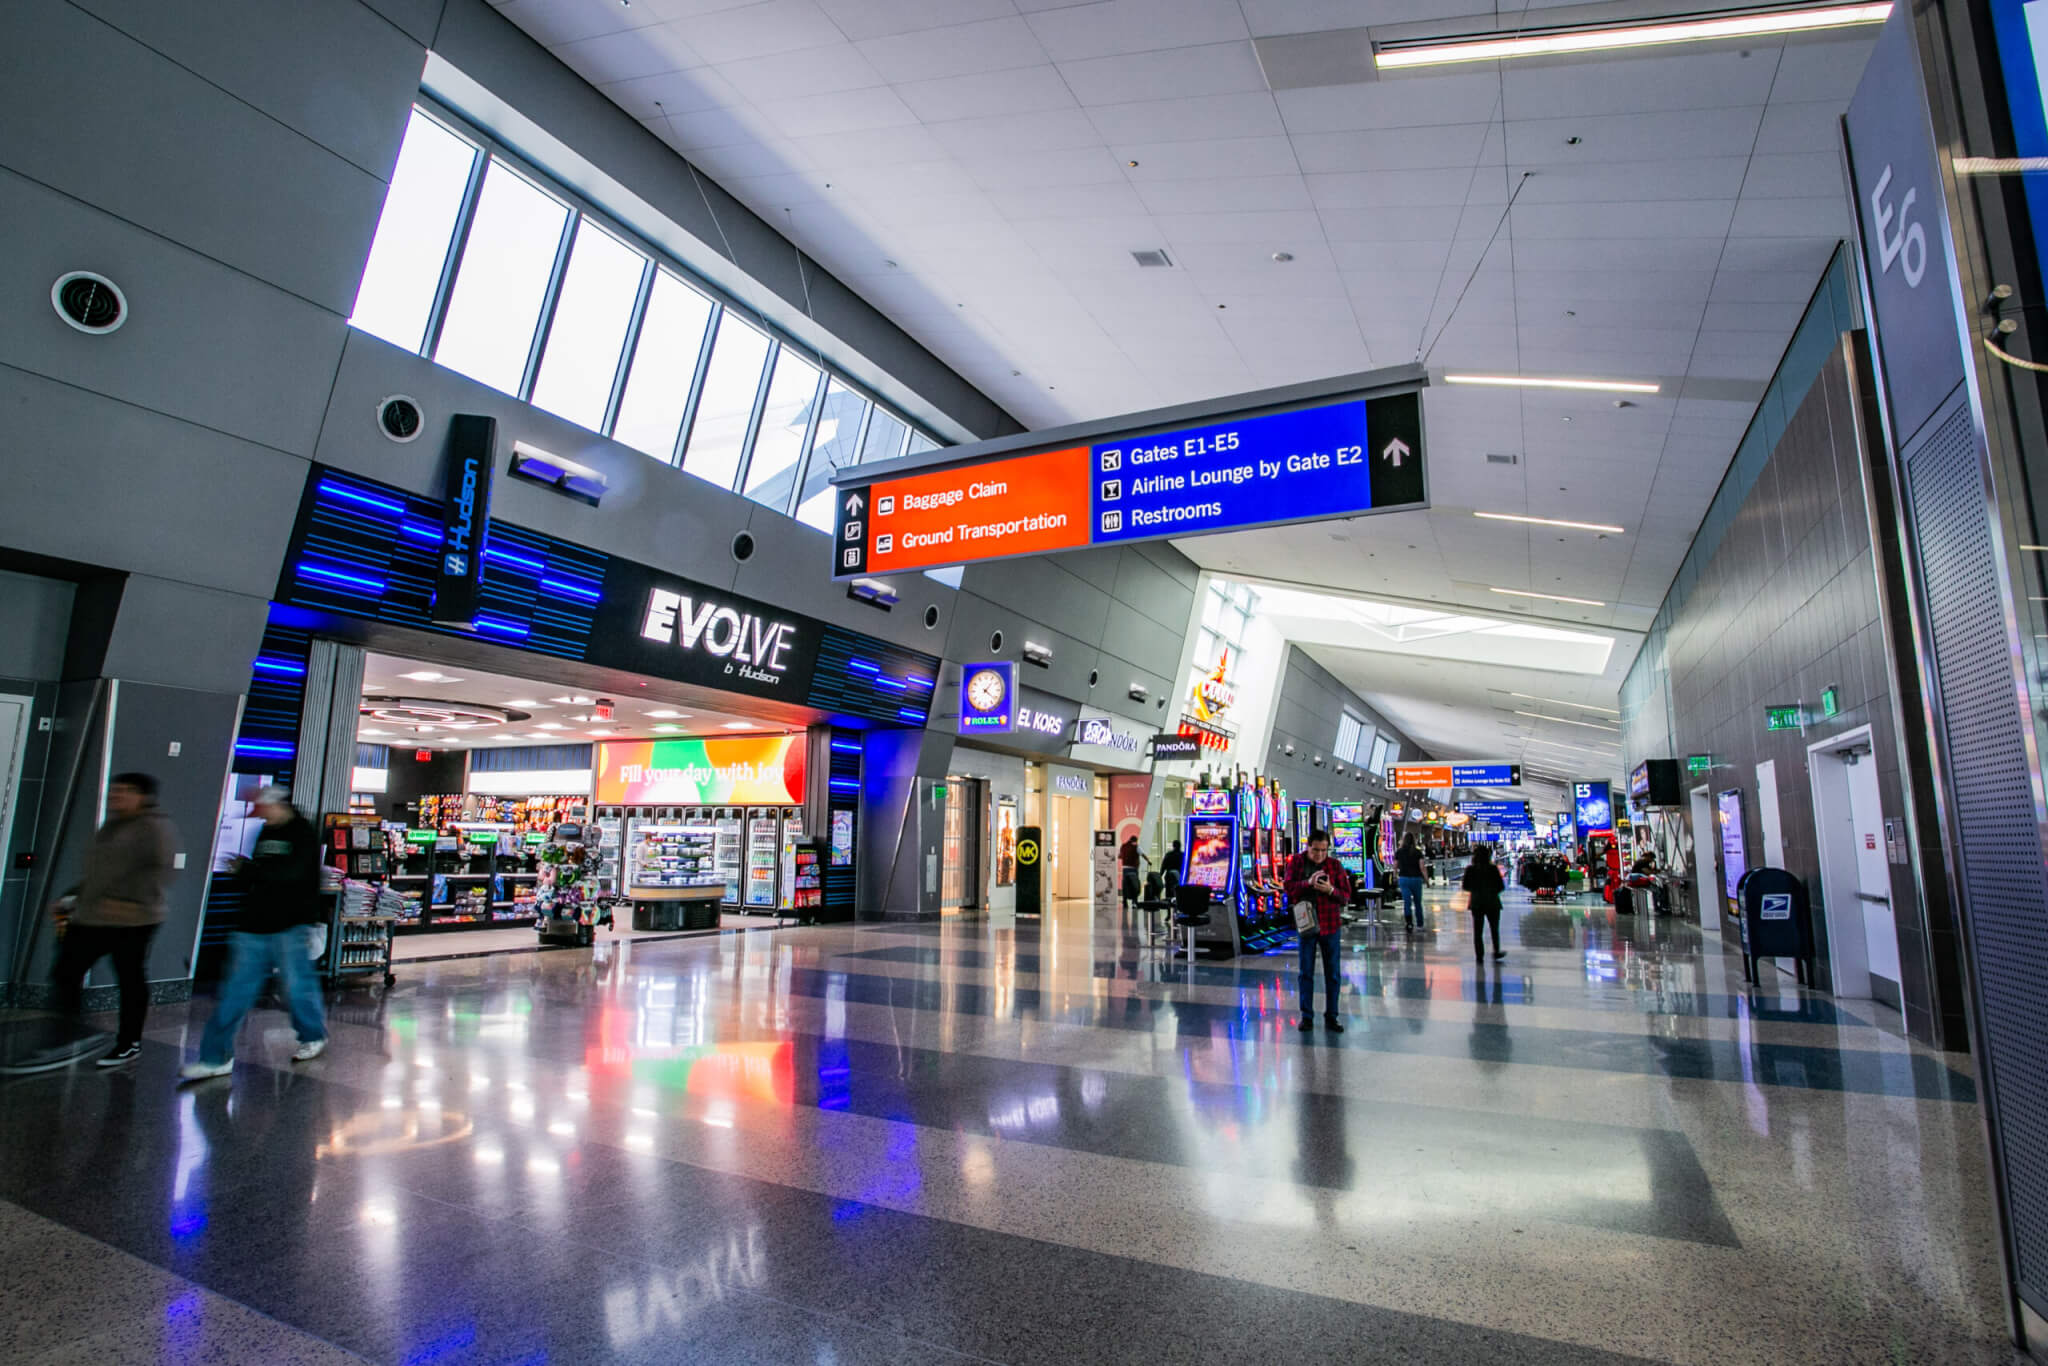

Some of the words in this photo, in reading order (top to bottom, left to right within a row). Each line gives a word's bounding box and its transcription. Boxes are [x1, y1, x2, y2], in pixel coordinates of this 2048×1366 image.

[1871, 163, 1927, 289] E6
[1130, 444, 1179, 465] Gates
[1184, 432, 1240, 457] E1-E5
[1131, 474, 1185, 496] Airline
[1190, 465, 1254, 487] Lounge
[1259, 460, 1281, 479] by
[1287, 453, 1330, 473] Gate
[1336, 446, 1363, 466] E2
[447, 457, 479, 550] Hudson
[903, 487, 964, 510] Baggage
[968, 481, 1008, 499] Claim
[1131, 501, 1222, 526] Restrooms
[901, 526, 954, 549] Ground
[957, 513, 1067, 541] Transportation
[641, 588, 796, 671] EVOLVE
[738, 664, 780, 685] Hudson
[971, 716, 999, 726] ROLEX
[1032, 711, 1063, 735] KORS
[620, 764, 642, 783] Fill
[644, 768, 684, 786] your
[684, 762, 713, 786] day
[716, 762, 754, 782] with
[754, 762, 784, 786] joy
[1576, 783, 1591, 799] E5
